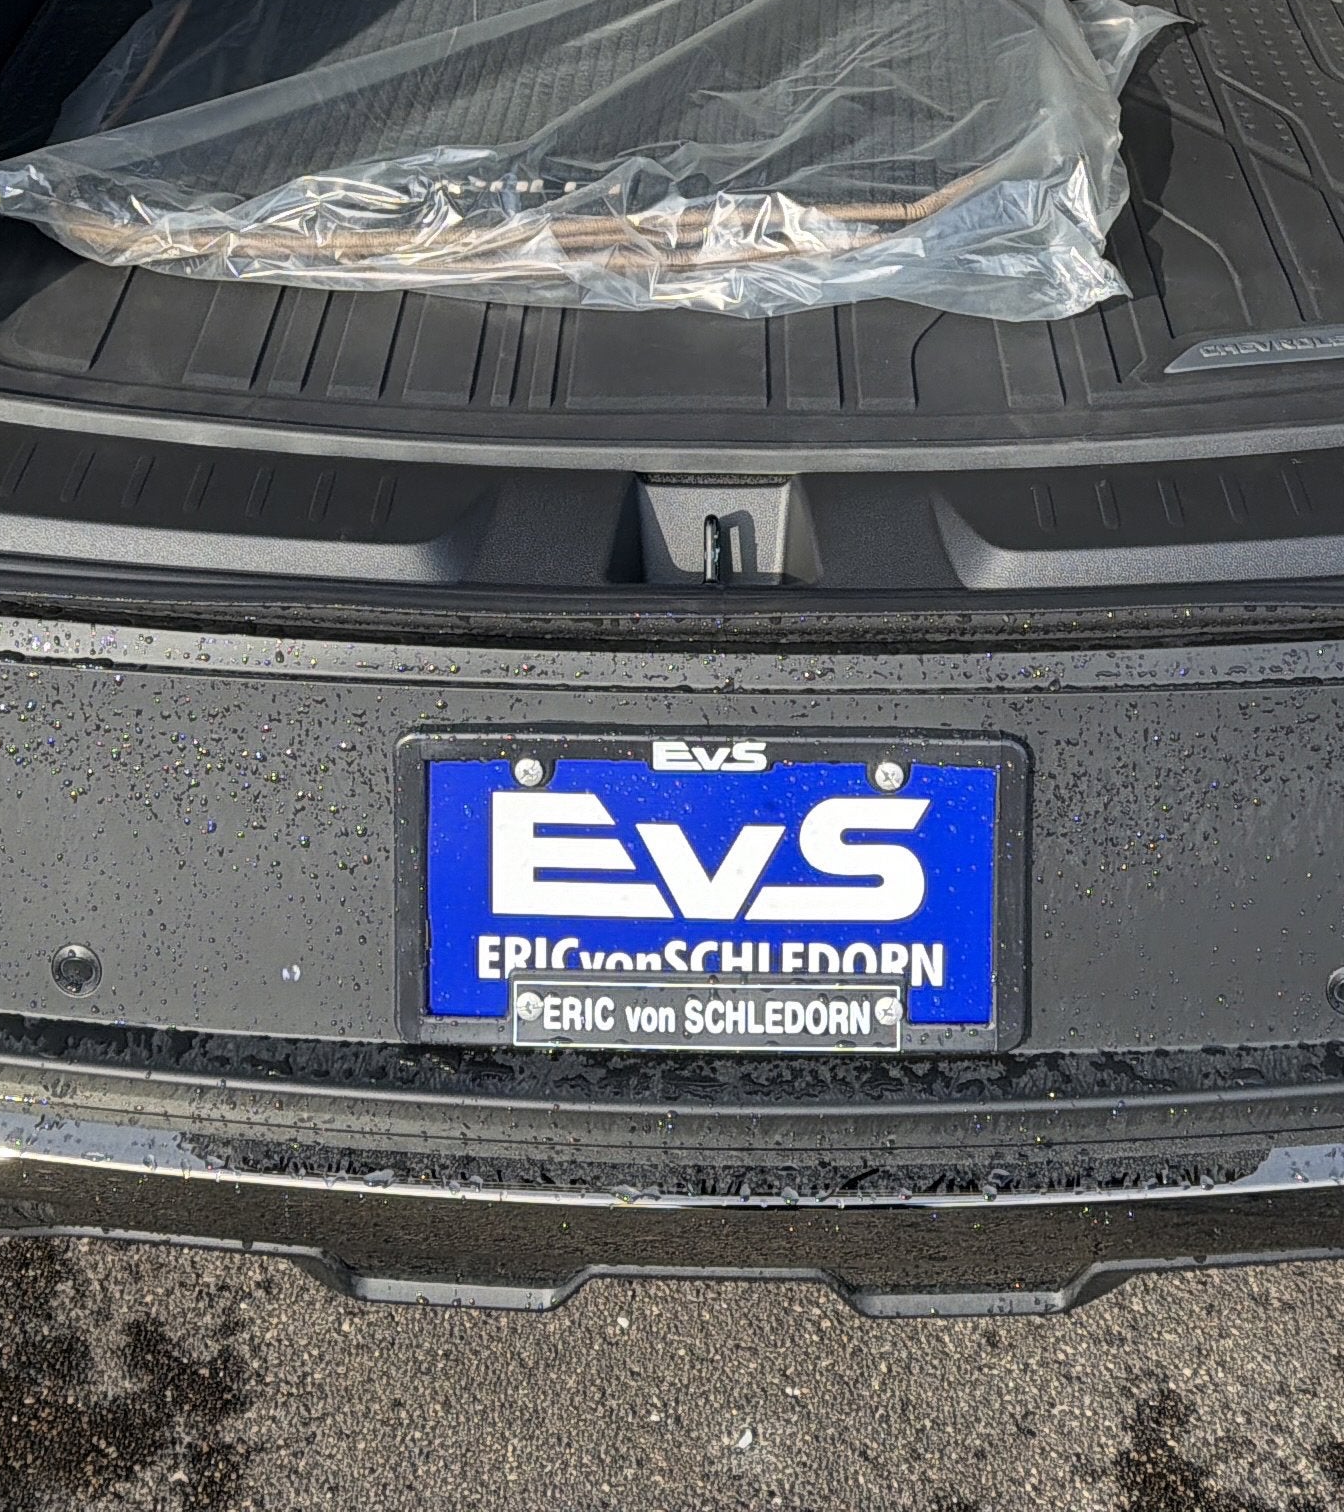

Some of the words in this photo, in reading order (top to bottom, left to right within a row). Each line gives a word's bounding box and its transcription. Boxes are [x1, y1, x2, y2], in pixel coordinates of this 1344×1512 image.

[543, 995, 616, 1032] ERIC
[624, 1004, 677, 1034] von
[683, 998, 872, 1036] SCHLEDORN
